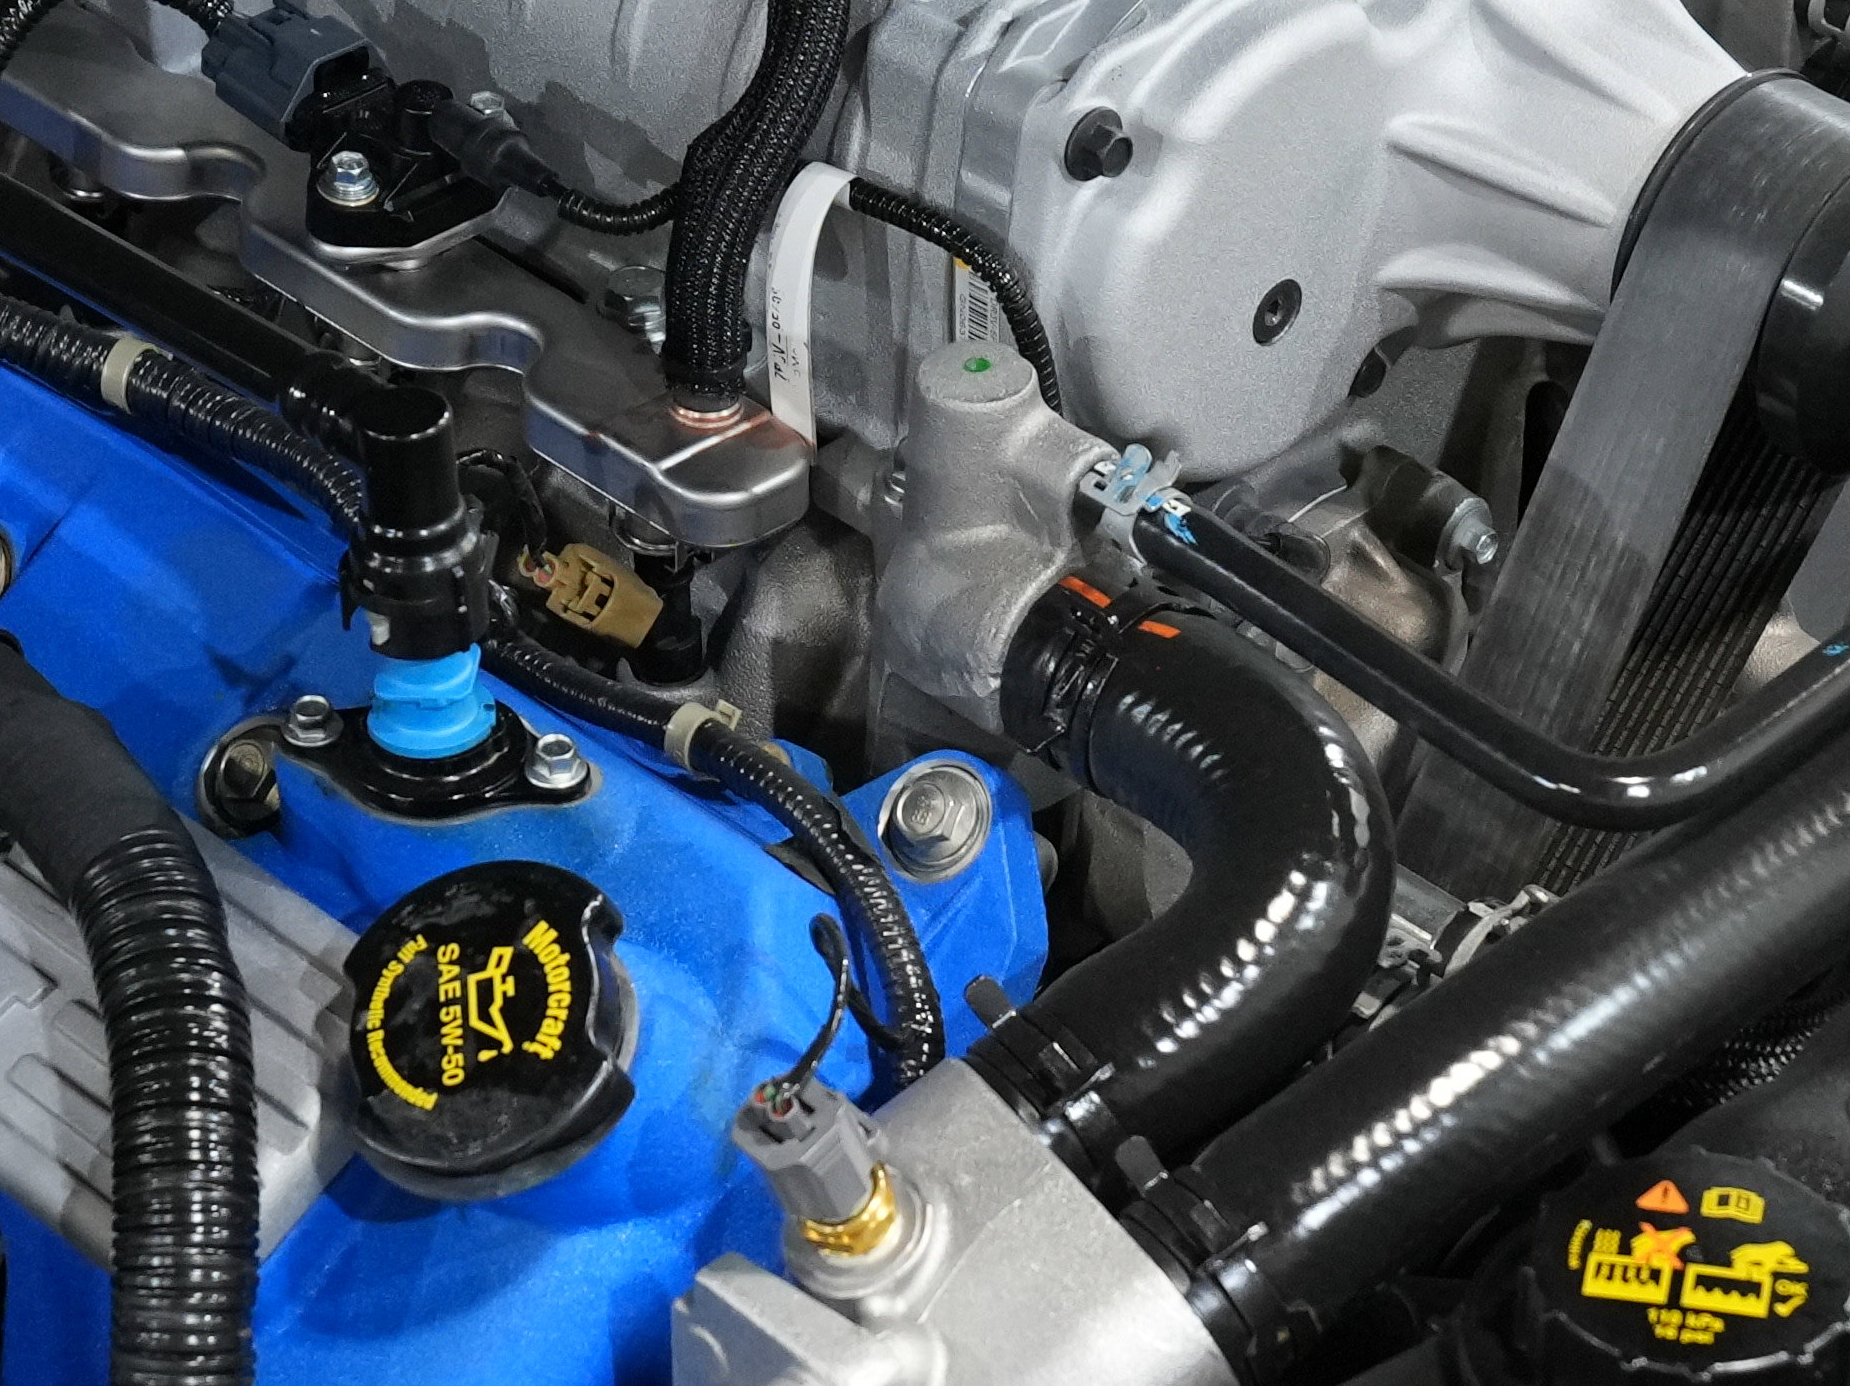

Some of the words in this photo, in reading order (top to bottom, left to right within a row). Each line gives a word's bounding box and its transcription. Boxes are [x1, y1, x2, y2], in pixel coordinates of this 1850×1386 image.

[396, 934, 429, 965] Full
[436, 942, 463, 1002] SAE
[522, 919, 572, 1062] Motorcraft
[438, 1006, 465, 1087] 5W-50
